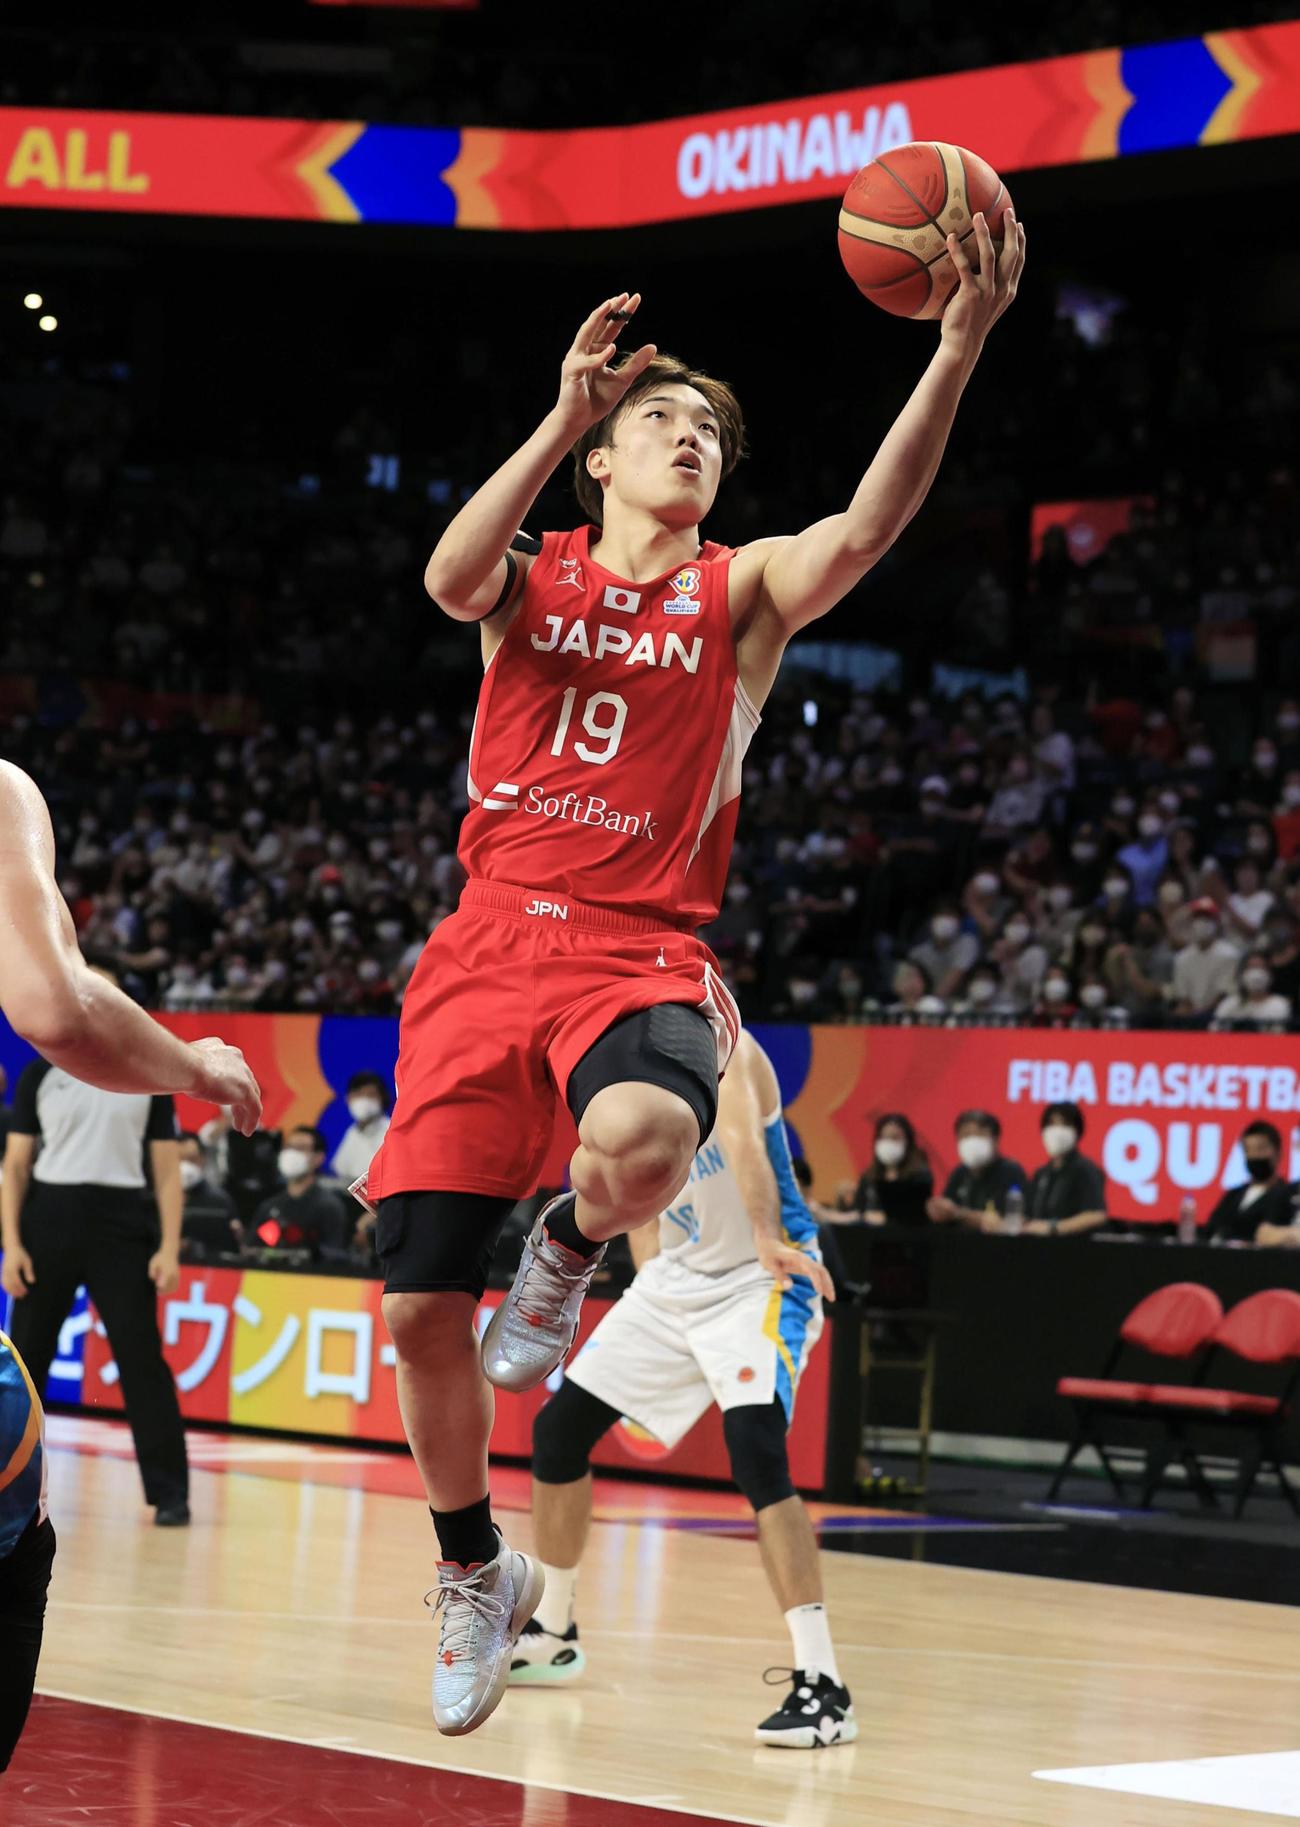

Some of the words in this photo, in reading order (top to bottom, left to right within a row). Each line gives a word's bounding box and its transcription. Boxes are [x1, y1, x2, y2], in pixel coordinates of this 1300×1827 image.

[5, 126, 149, 194] ALL
[676, 101, 912, 200] OKINAWA
[530, 614, 703, 675] JAPAN
[550, 686, 628, 765] 19
[524, 786, 658, 841] SoftBank
[525, 900, 568, 920] JPN
[1007, 1059, 1098, 1103] FIBA
[1106, 1062, 1300, 1112] BASKETB
